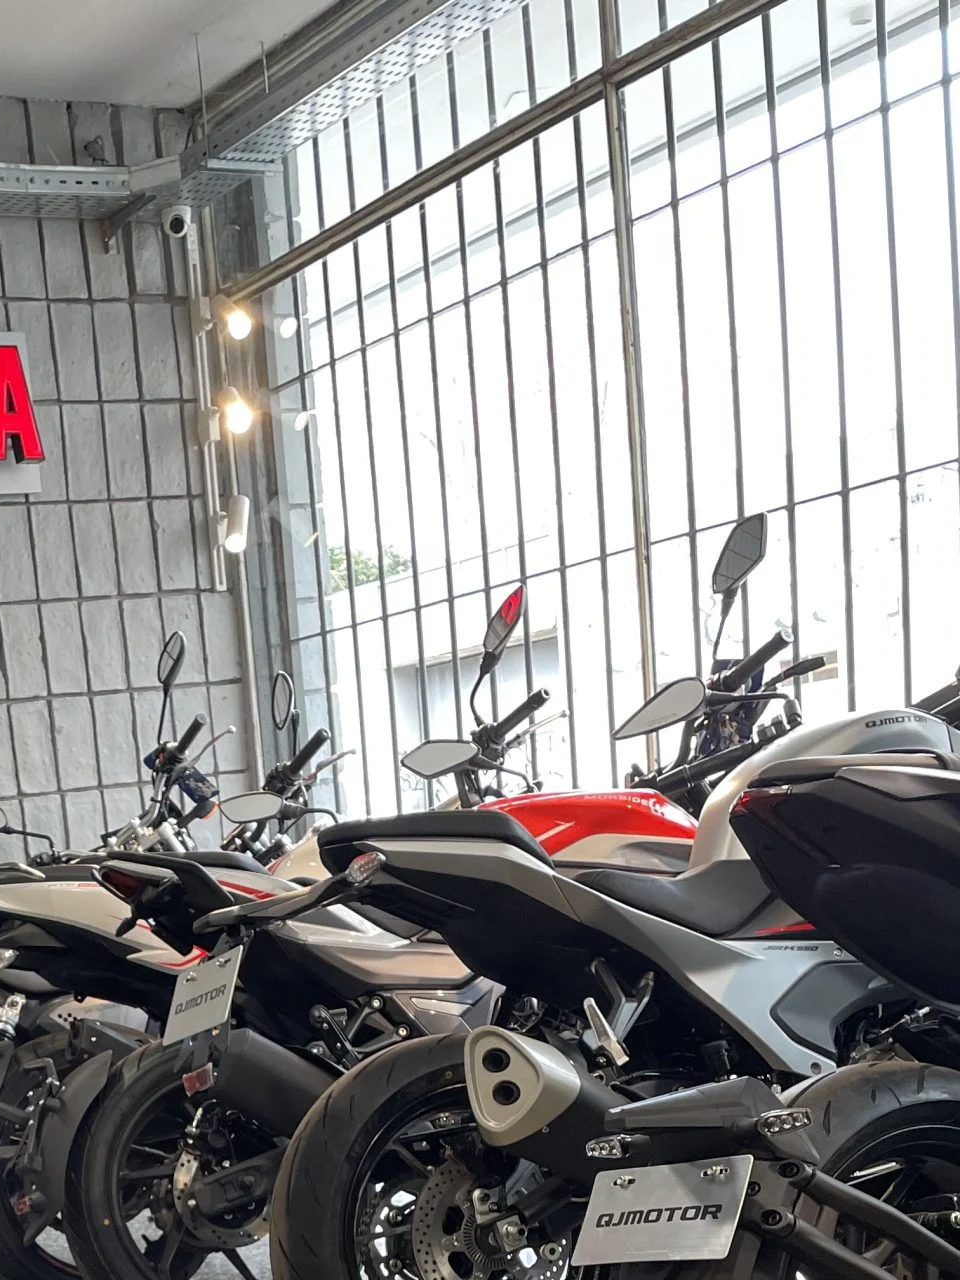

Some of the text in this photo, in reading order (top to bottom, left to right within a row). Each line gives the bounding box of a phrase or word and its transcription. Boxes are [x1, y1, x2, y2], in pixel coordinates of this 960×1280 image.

[864, 715, 929, 729] QJMOTOR
[174, 983, 227, 1016] QJMOTOR
[595, 1203, 723, 1229] QJMOTOR
